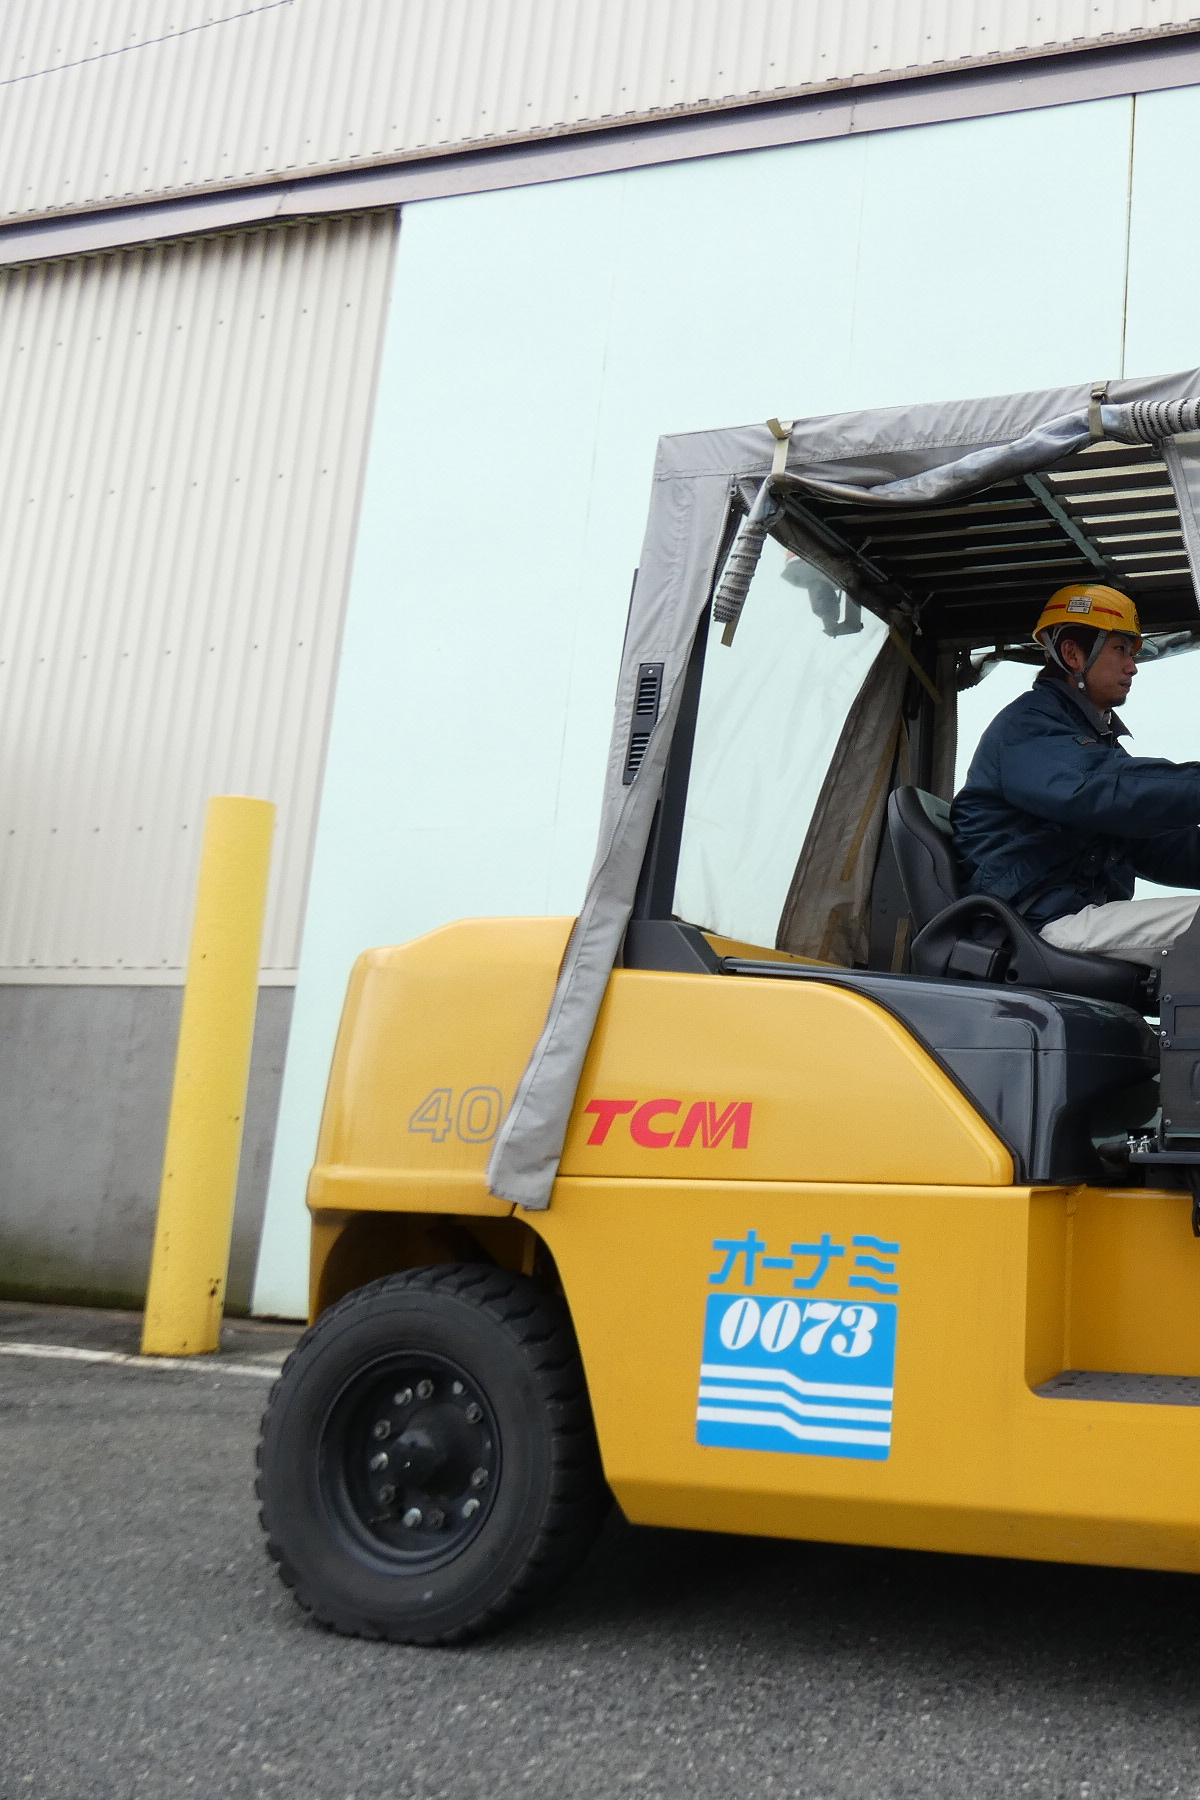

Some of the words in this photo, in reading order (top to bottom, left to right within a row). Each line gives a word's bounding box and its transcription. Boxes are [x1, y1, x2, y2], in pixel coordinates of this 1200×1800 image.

[408, 1086, 504, 1143] 40
[584, 1099, 753, 1149] TCM
[708, 1230, 900, 1294] オーナミ
[720, 1298, 878, 1357] 0073
